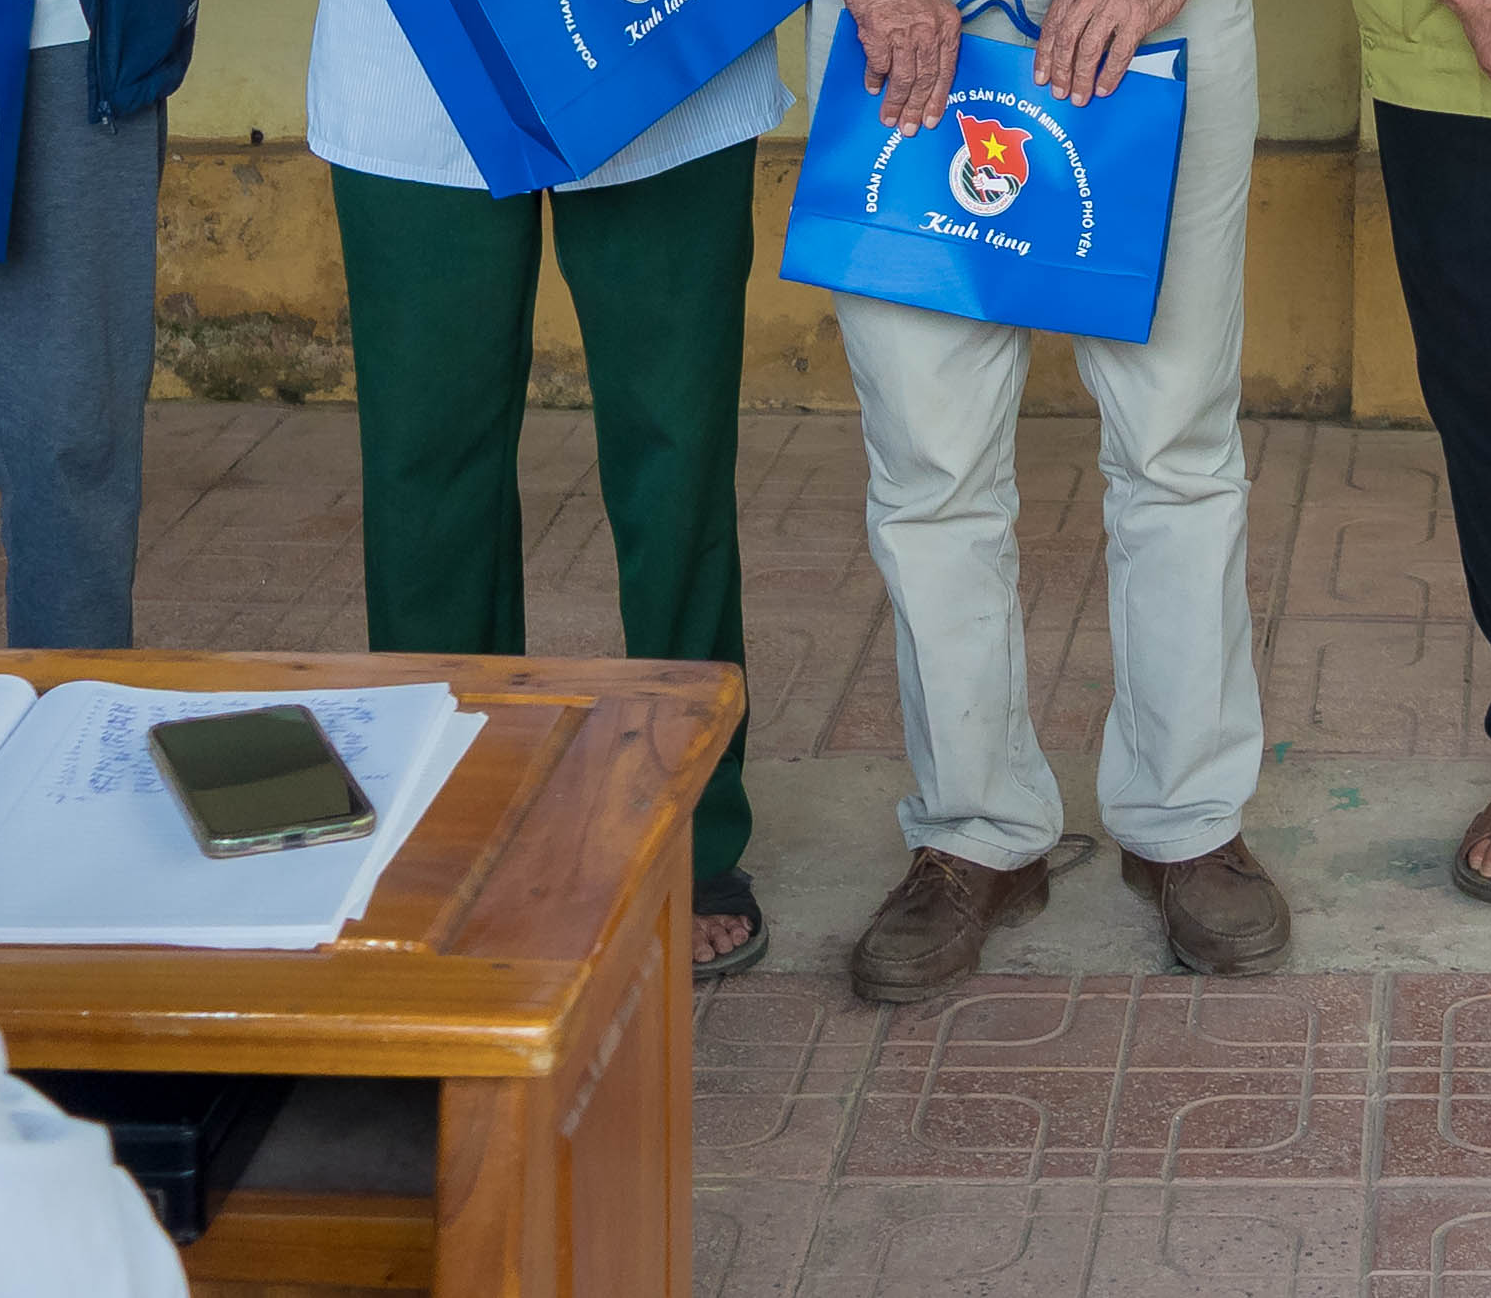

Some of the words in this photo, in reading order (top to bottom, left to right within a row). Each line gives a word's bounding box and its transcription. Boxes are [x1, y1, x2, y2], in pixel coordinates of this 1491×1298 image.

[969, 88, 993, 101] SẢN
[1037, 112, 1066, 142] MINH
[1076, 231, 1092, 258] YÊN
[919, 211, 979, 240] Kính
[985, 229, 1032, 256] tặng
